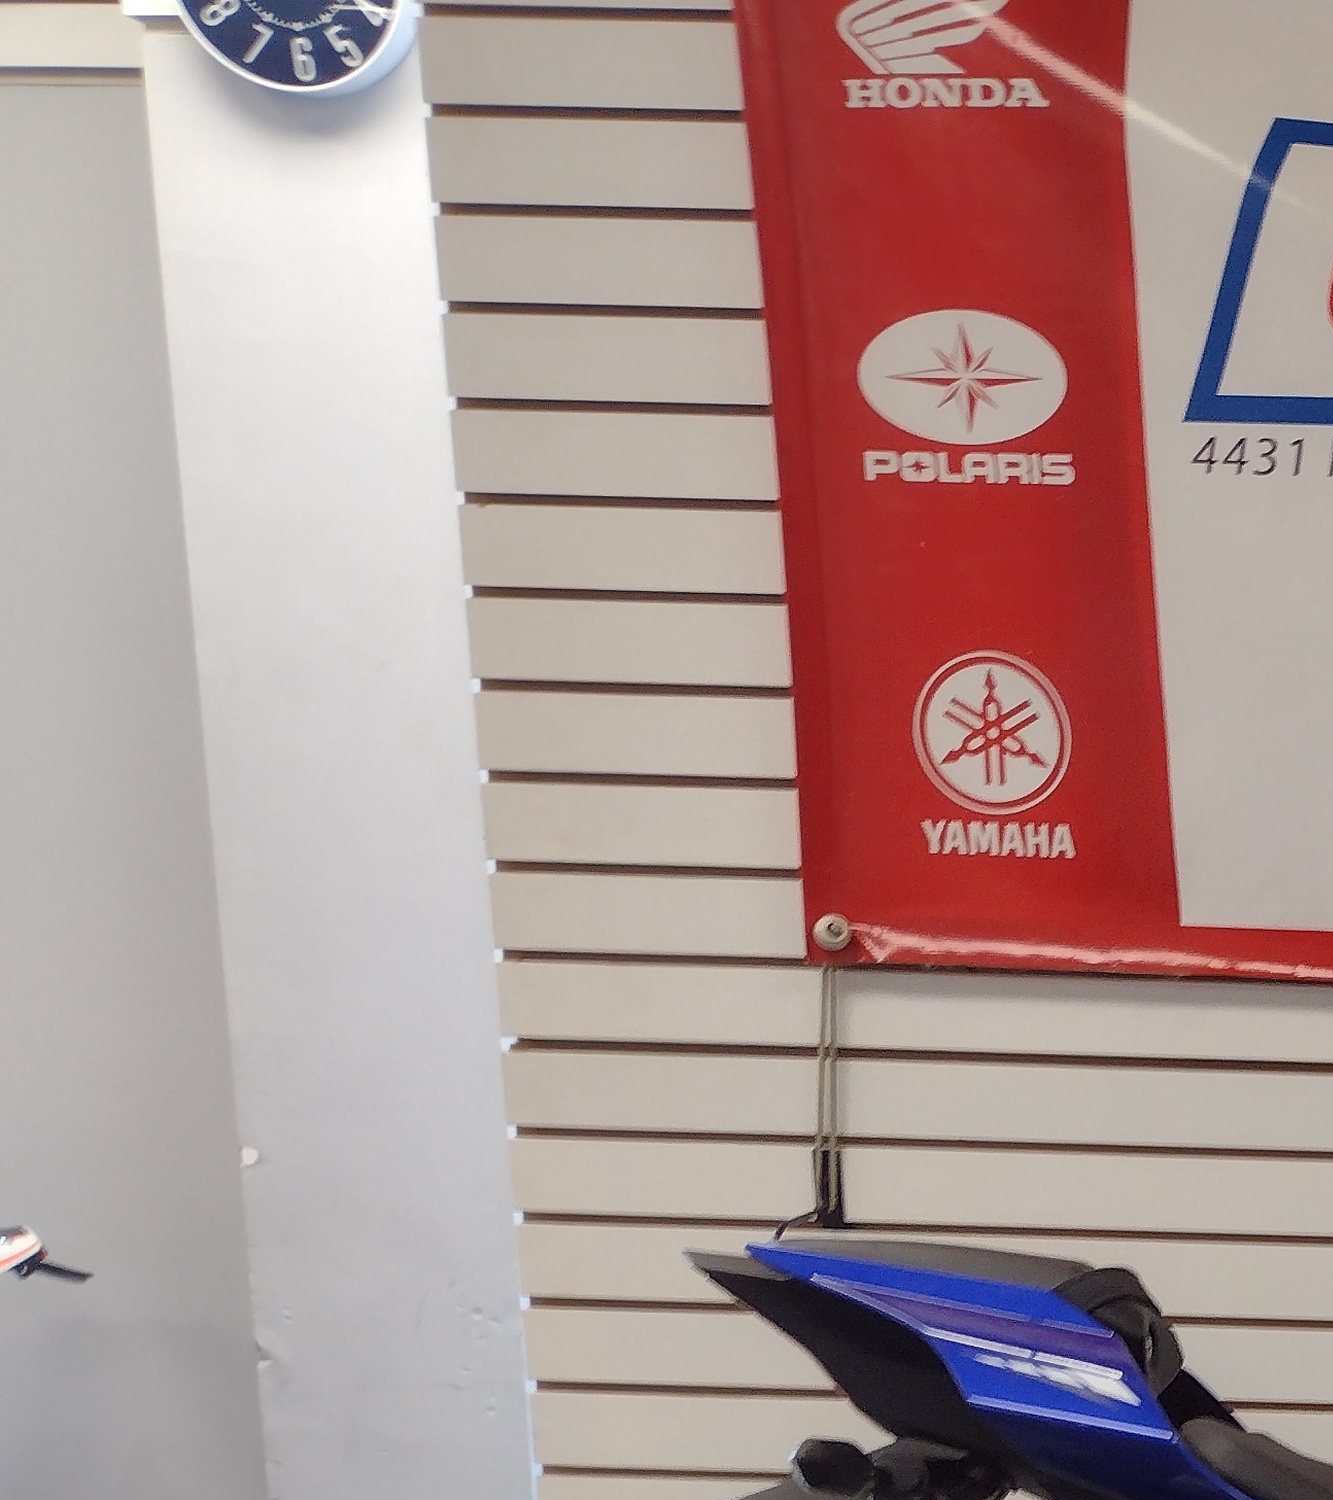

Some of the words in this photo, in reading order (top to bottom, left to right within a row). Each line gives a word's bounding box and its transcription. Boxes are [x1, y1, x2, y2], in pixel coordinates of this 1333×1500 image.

[242, 23, 274, 64] 7
[289, 37, 317, 82] 6
[323, 25, 365, 68] 5
[842, 77, 1050, 108] HONDA
[863, 450, 1076, 486] POLARIS
[1190, 436, 1306, 478] 4431
[920, 819, 1077, 859] YAMAHA
